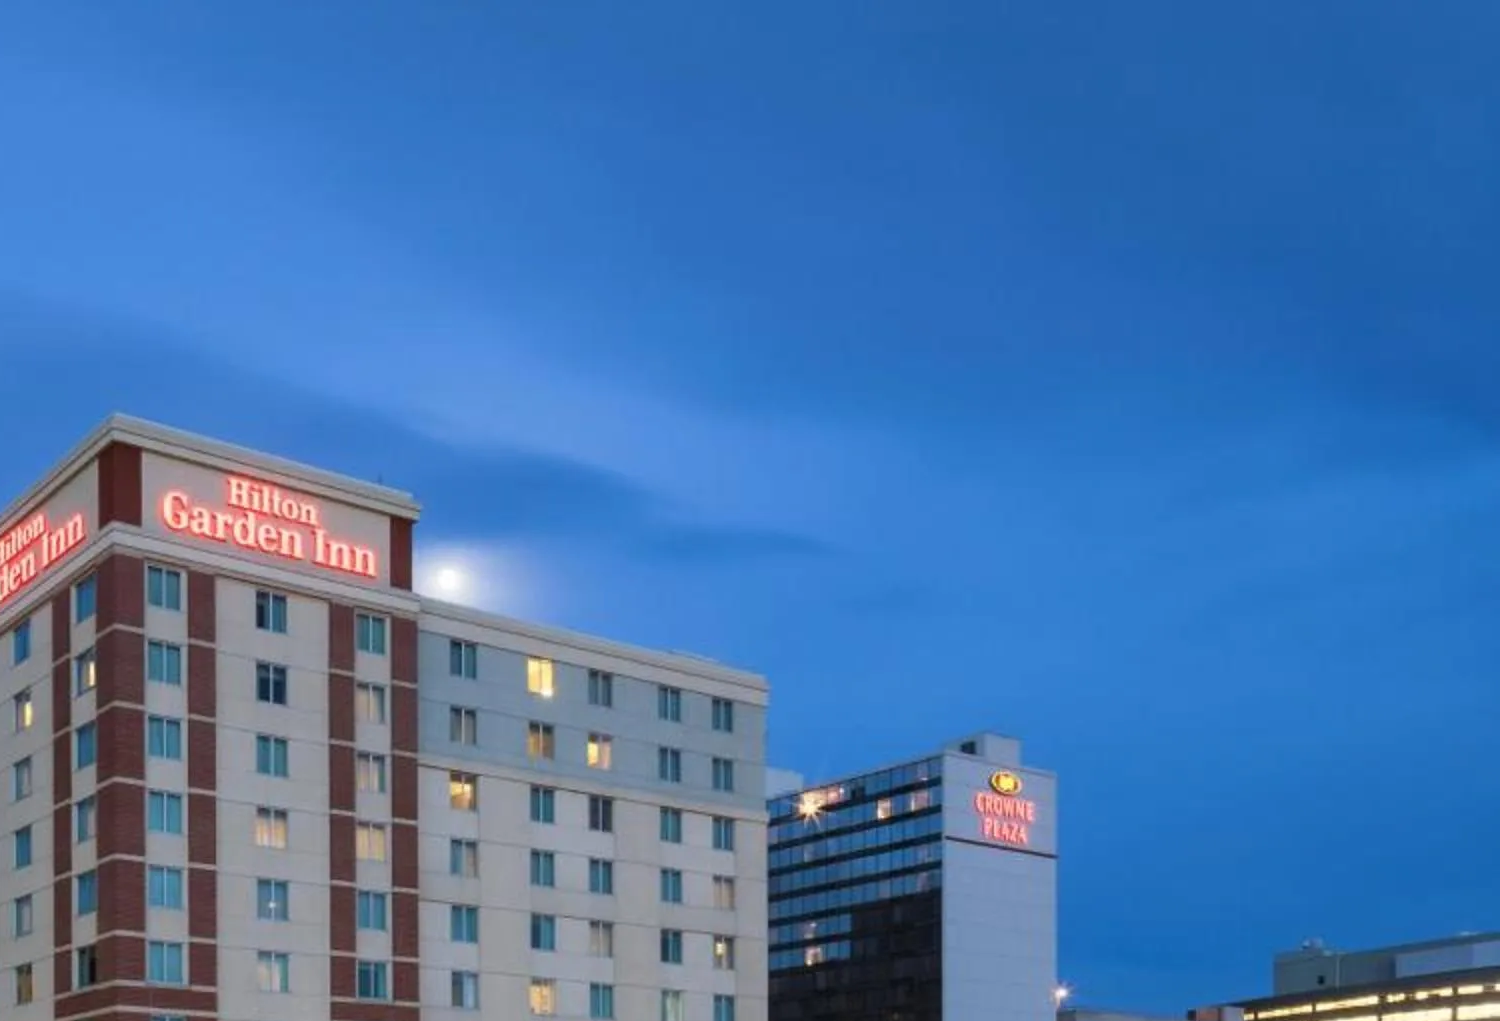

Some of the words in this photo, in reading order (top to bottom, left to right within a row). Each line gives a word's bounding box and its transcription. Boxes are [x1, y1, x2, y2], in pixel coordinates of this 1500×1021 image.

[228, 477, 320, 525] Hilton
[41, 513, 85, 568] Inn
[163, 491, 304, 560] Garden
[312, 527, 378, 578] Inn
[975, 792, 1036, 823] CROWNE
[983, 816, 1028, 845] PLAZA
